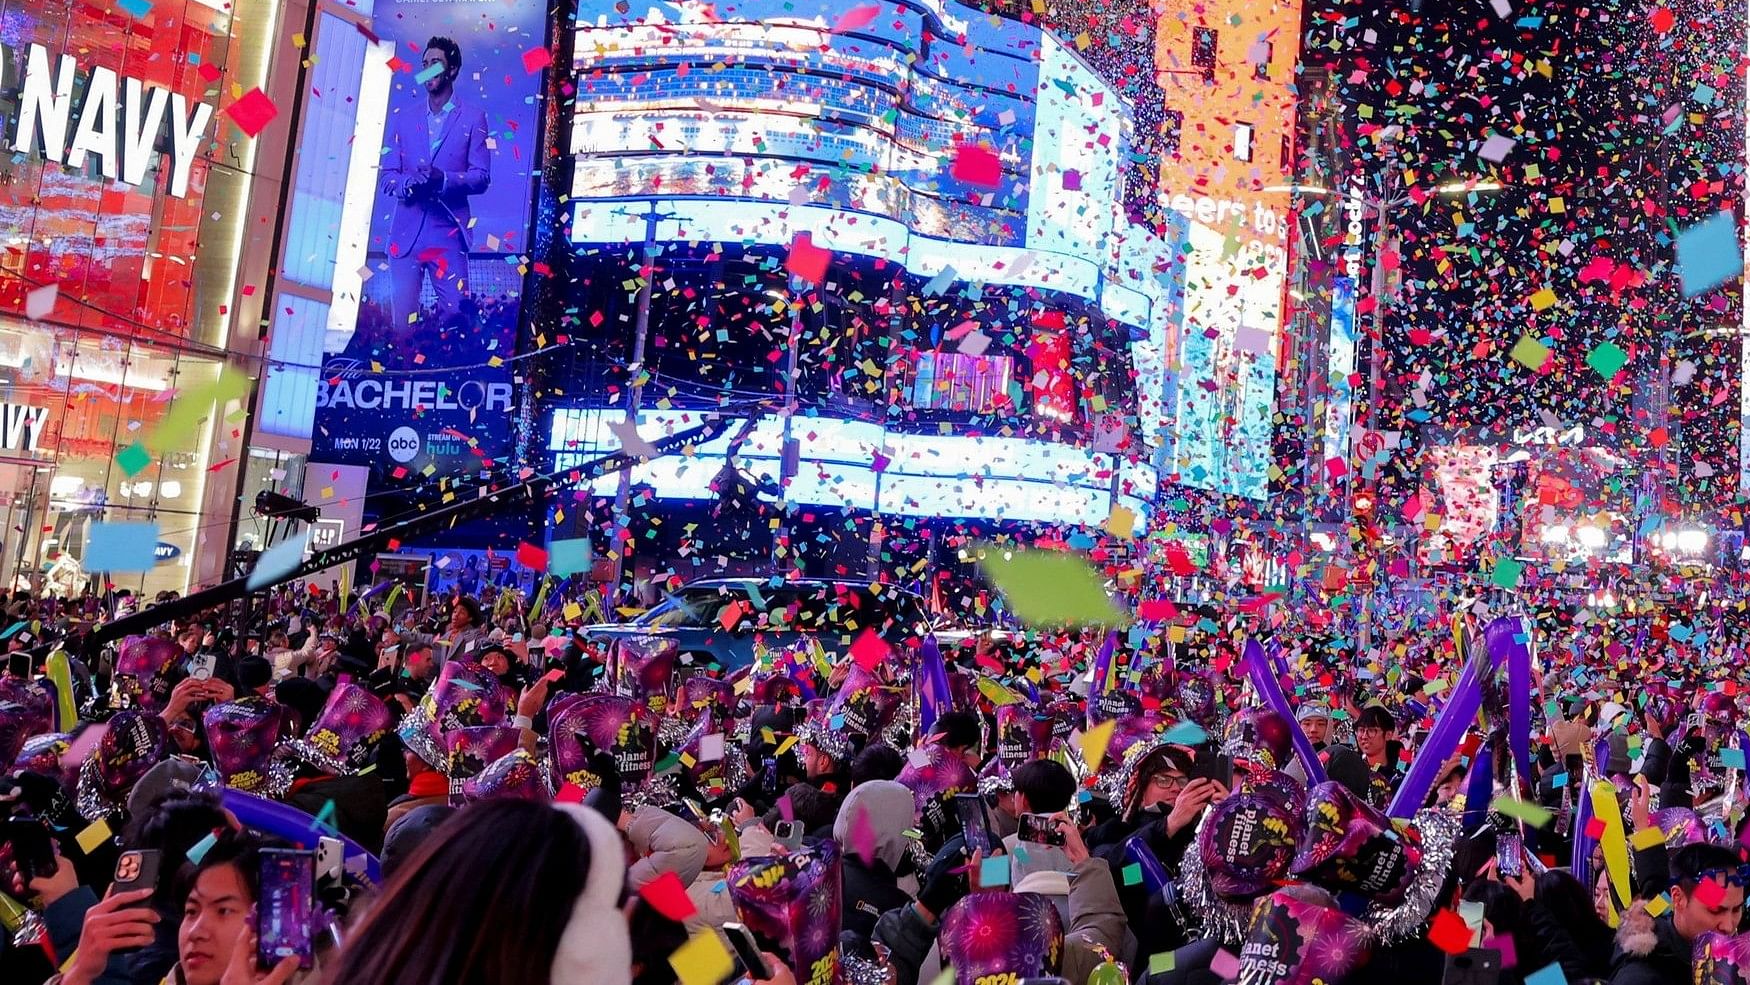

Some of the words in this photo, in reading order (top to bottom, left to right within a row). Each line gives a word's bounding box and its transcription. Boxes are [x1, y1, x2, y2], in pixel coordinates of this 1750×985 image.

[16, 43, 213, 199] NAVY
[335, 437, 359, 450] MON
[362, 437, 381, 451] 1/22
[391, 436, 417, 450] abc
[426, 441, 459, 455] hulu
[315, 530, 335, 545] GAP
[841, 704, 867, 725] planet
[615, 751, 647, 764] planet
[620, 761, 651, 773] fitness
[229, 770, 257, 785] 2024
[1227, 813, 1245, 863] fitness
[1239, 809, 1257, 856] planet
[1360, 850, 1389, 891] planet
[1370, 845, 1401, 891] fitness
